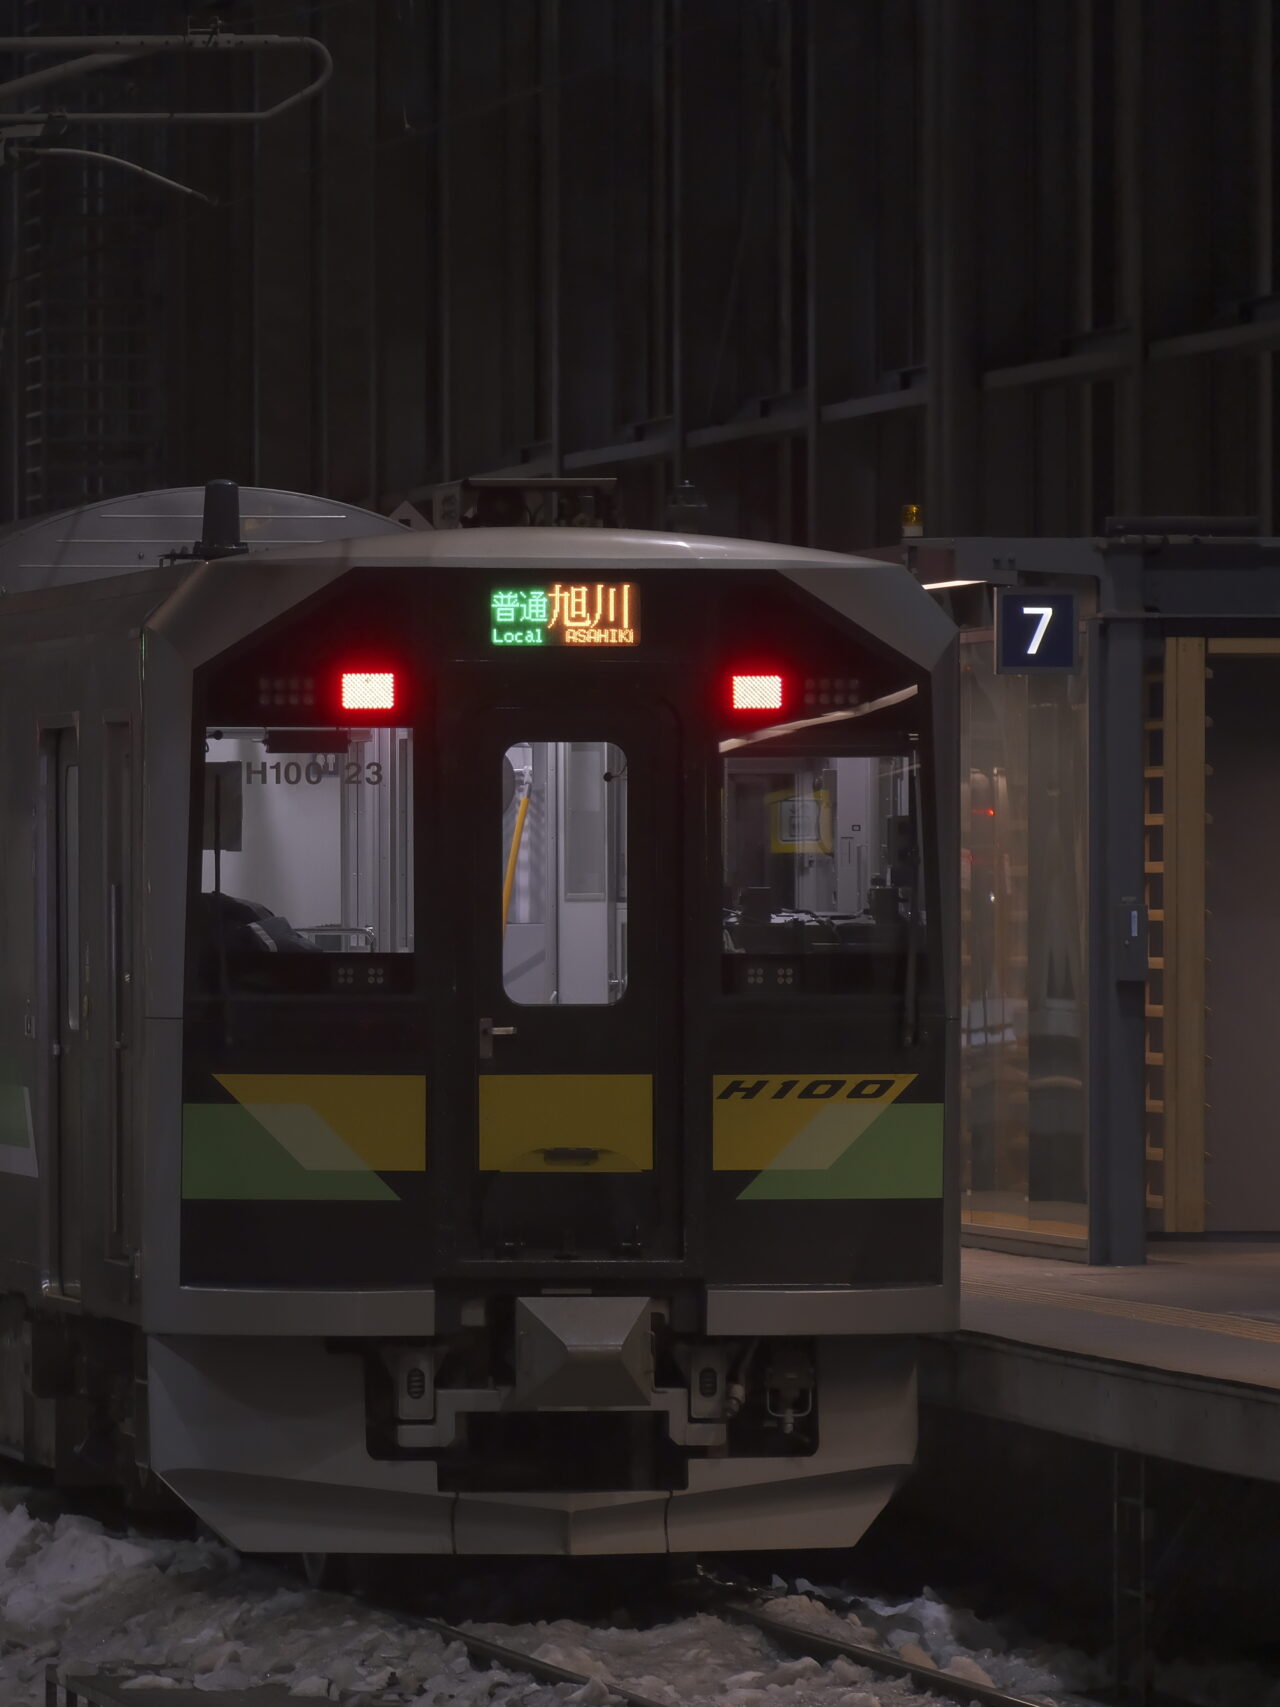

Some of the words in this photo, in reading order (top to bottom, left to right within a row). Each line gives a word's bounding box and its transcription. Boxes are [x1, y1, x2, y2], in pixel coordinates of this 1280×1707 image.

[491, 591, 549, 622] 普通
[548, 584, 631, 629] 旭川
[493, 628, 543, 643] Local
[1022, 606, 1054, 655] 7
[716, 1079, 896, 1100] H100
